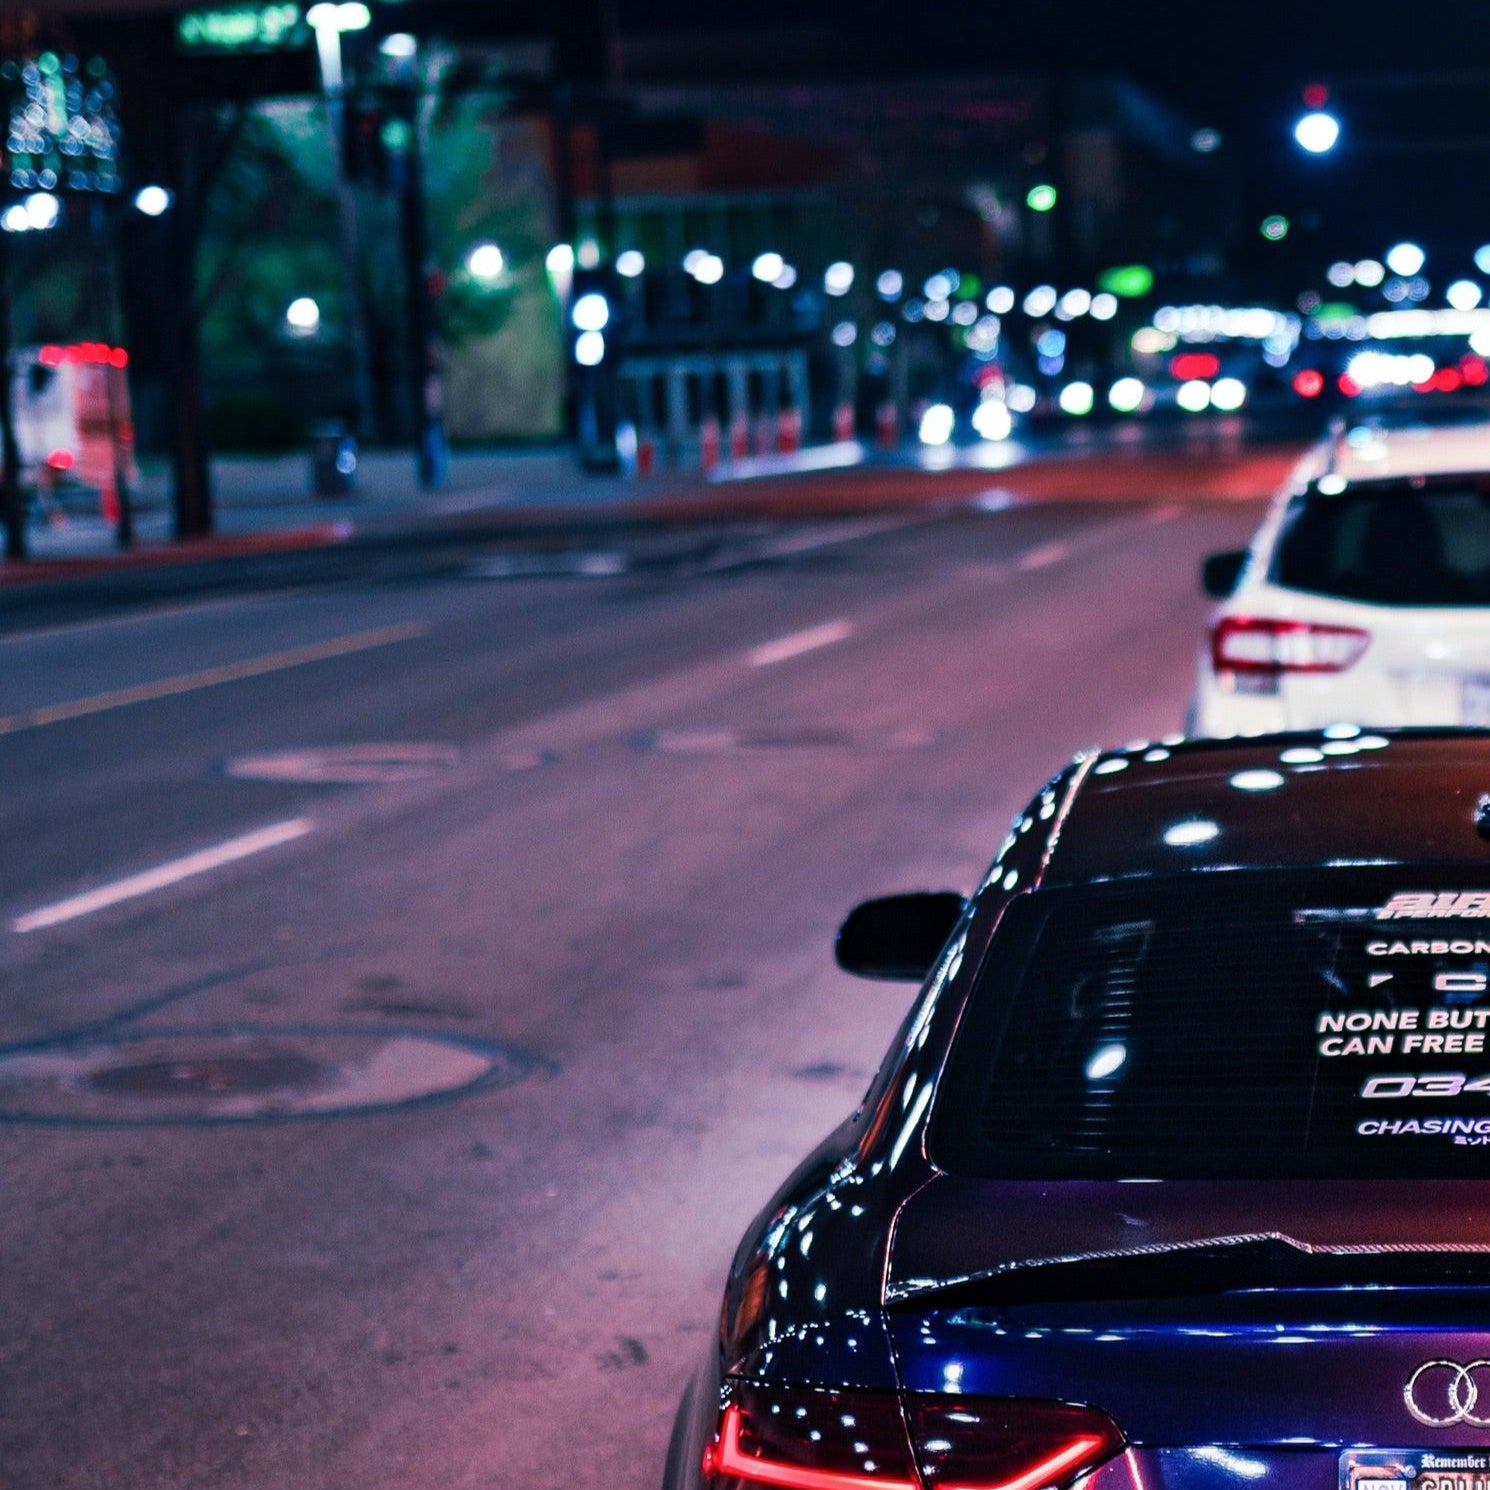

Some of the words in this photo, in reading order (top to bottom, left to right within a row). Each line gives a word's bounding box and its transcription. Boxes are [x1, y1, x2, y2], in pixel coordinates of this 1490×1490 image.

[1319, 1012, 1419, 1033] NONE
[1320, 1037, 1394, 1057] CAN
[1402, 1034, 1485, 1054] FREE
[1421, 1453, 1487, 1469] Remember
